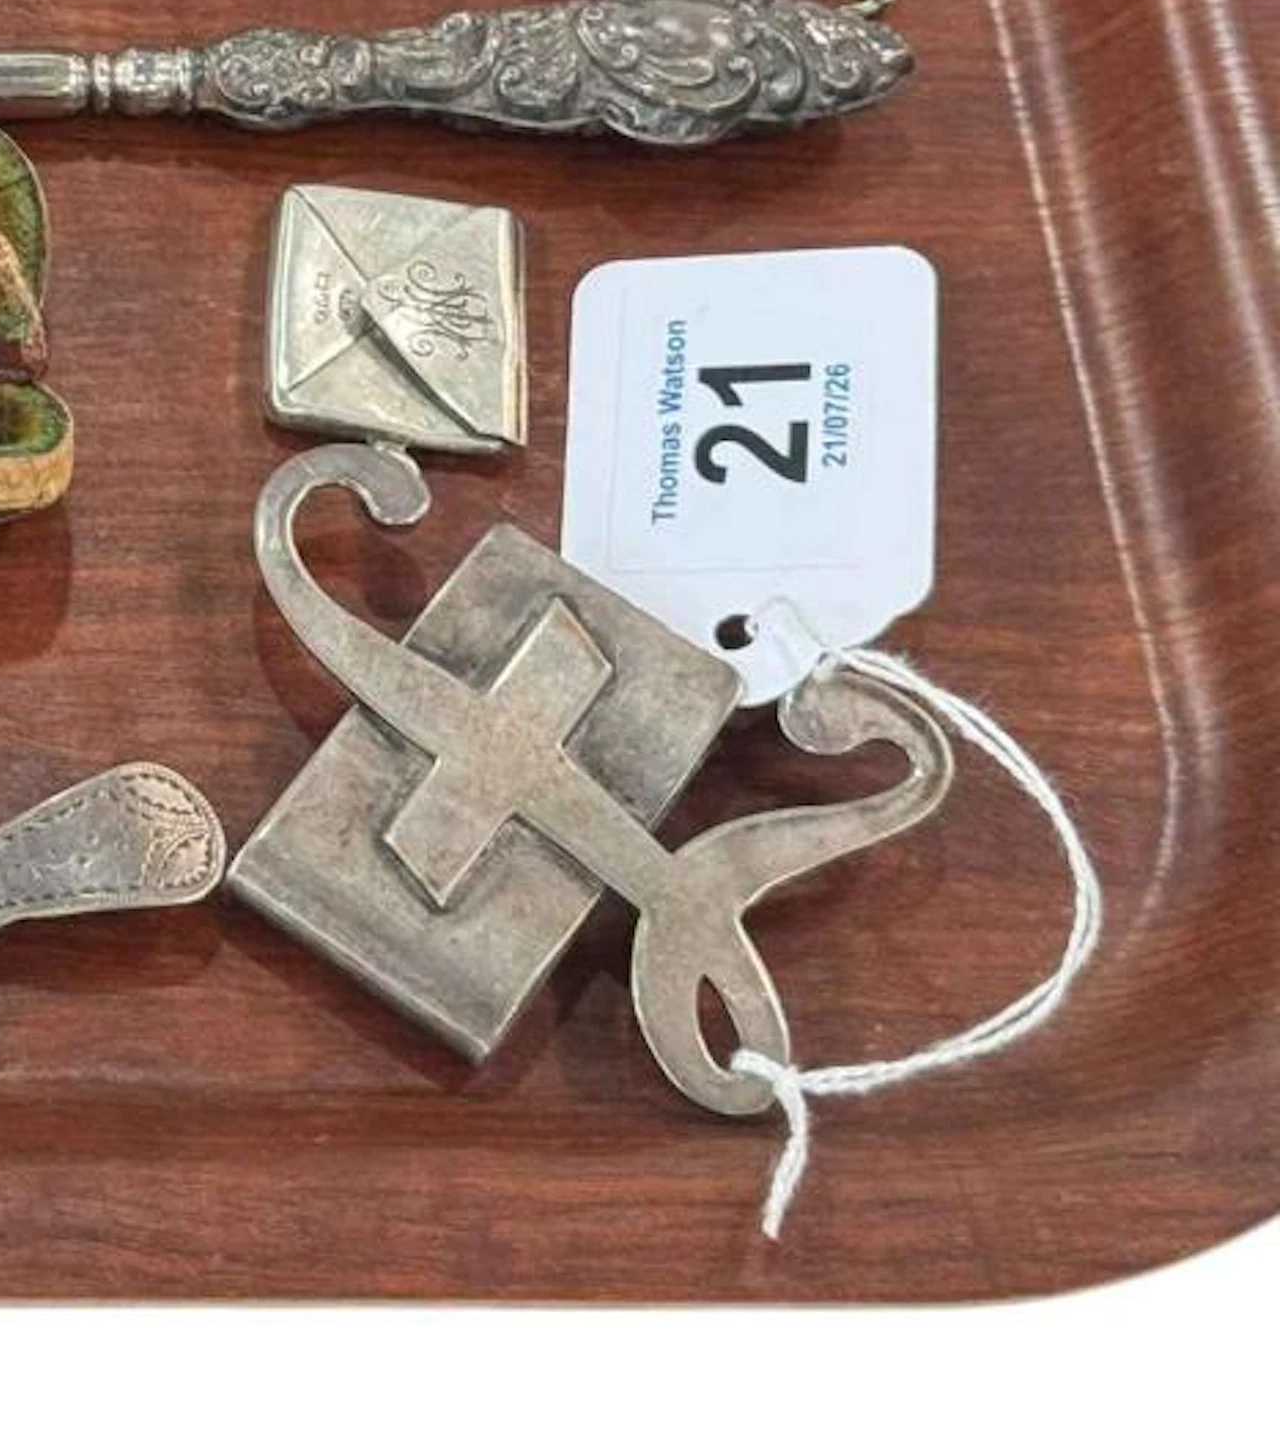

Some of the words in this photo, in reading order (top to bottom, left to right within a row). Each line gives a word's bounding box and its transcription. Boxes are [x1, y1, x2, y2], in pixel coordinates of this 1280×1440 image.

[657, 320, 688, 415] Watson
[822, 363, 851, 468] 21/07/26
[651, 421, 682, 524] Thomas
[694, 363, 811, 484] 21
